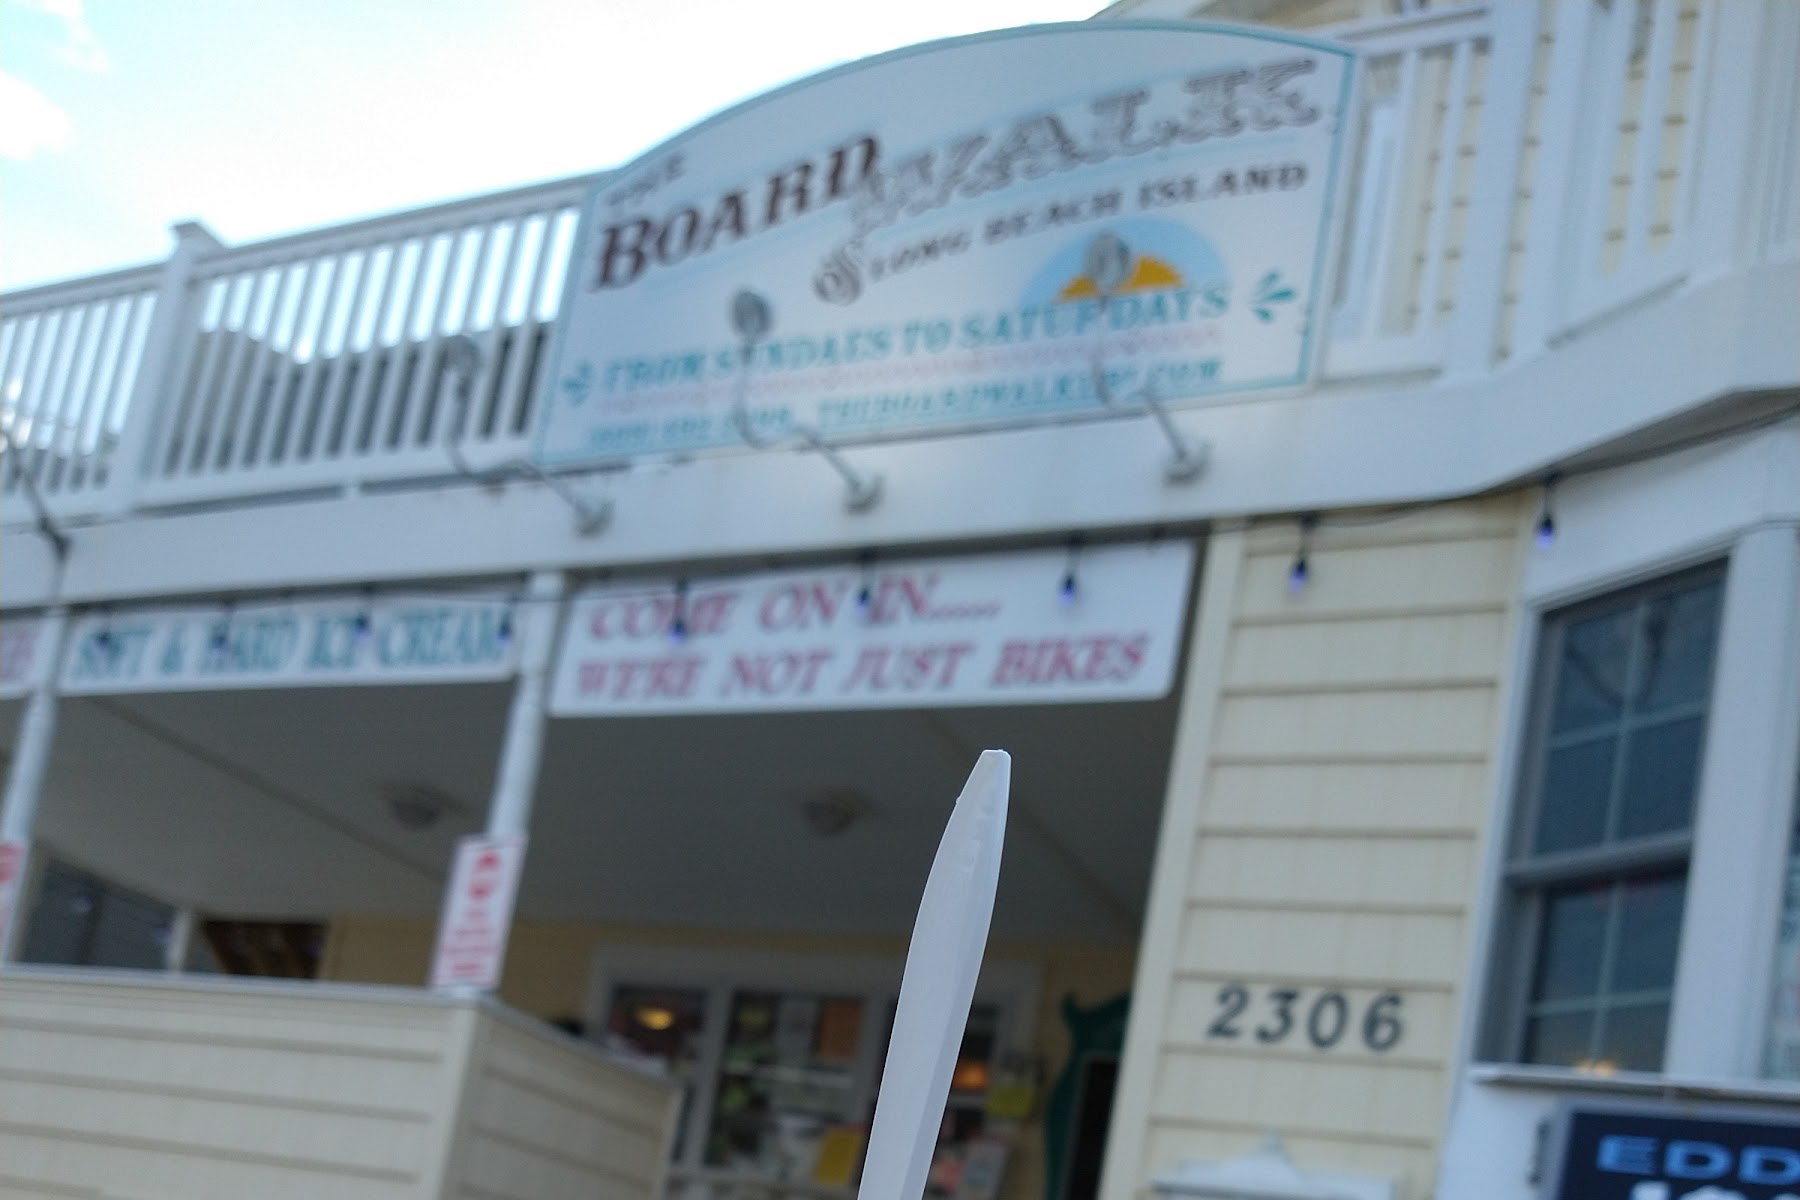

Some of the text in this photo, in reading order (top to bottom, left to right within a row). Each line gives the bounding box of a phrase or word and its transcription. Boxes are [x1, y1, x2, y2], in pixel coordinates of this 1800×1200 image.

[868, 160, 1308, 282] LONG BEACH ISLAND
[903, 313, 951, 355] TO
[758, 576, 850, 634] ON
[715, 645, 836, 699] NOT
[843, 638, 980, 694] JUST
[988, 628, 1155, 690] BIKES
[1206, 983, 1407, 1052] 2306
